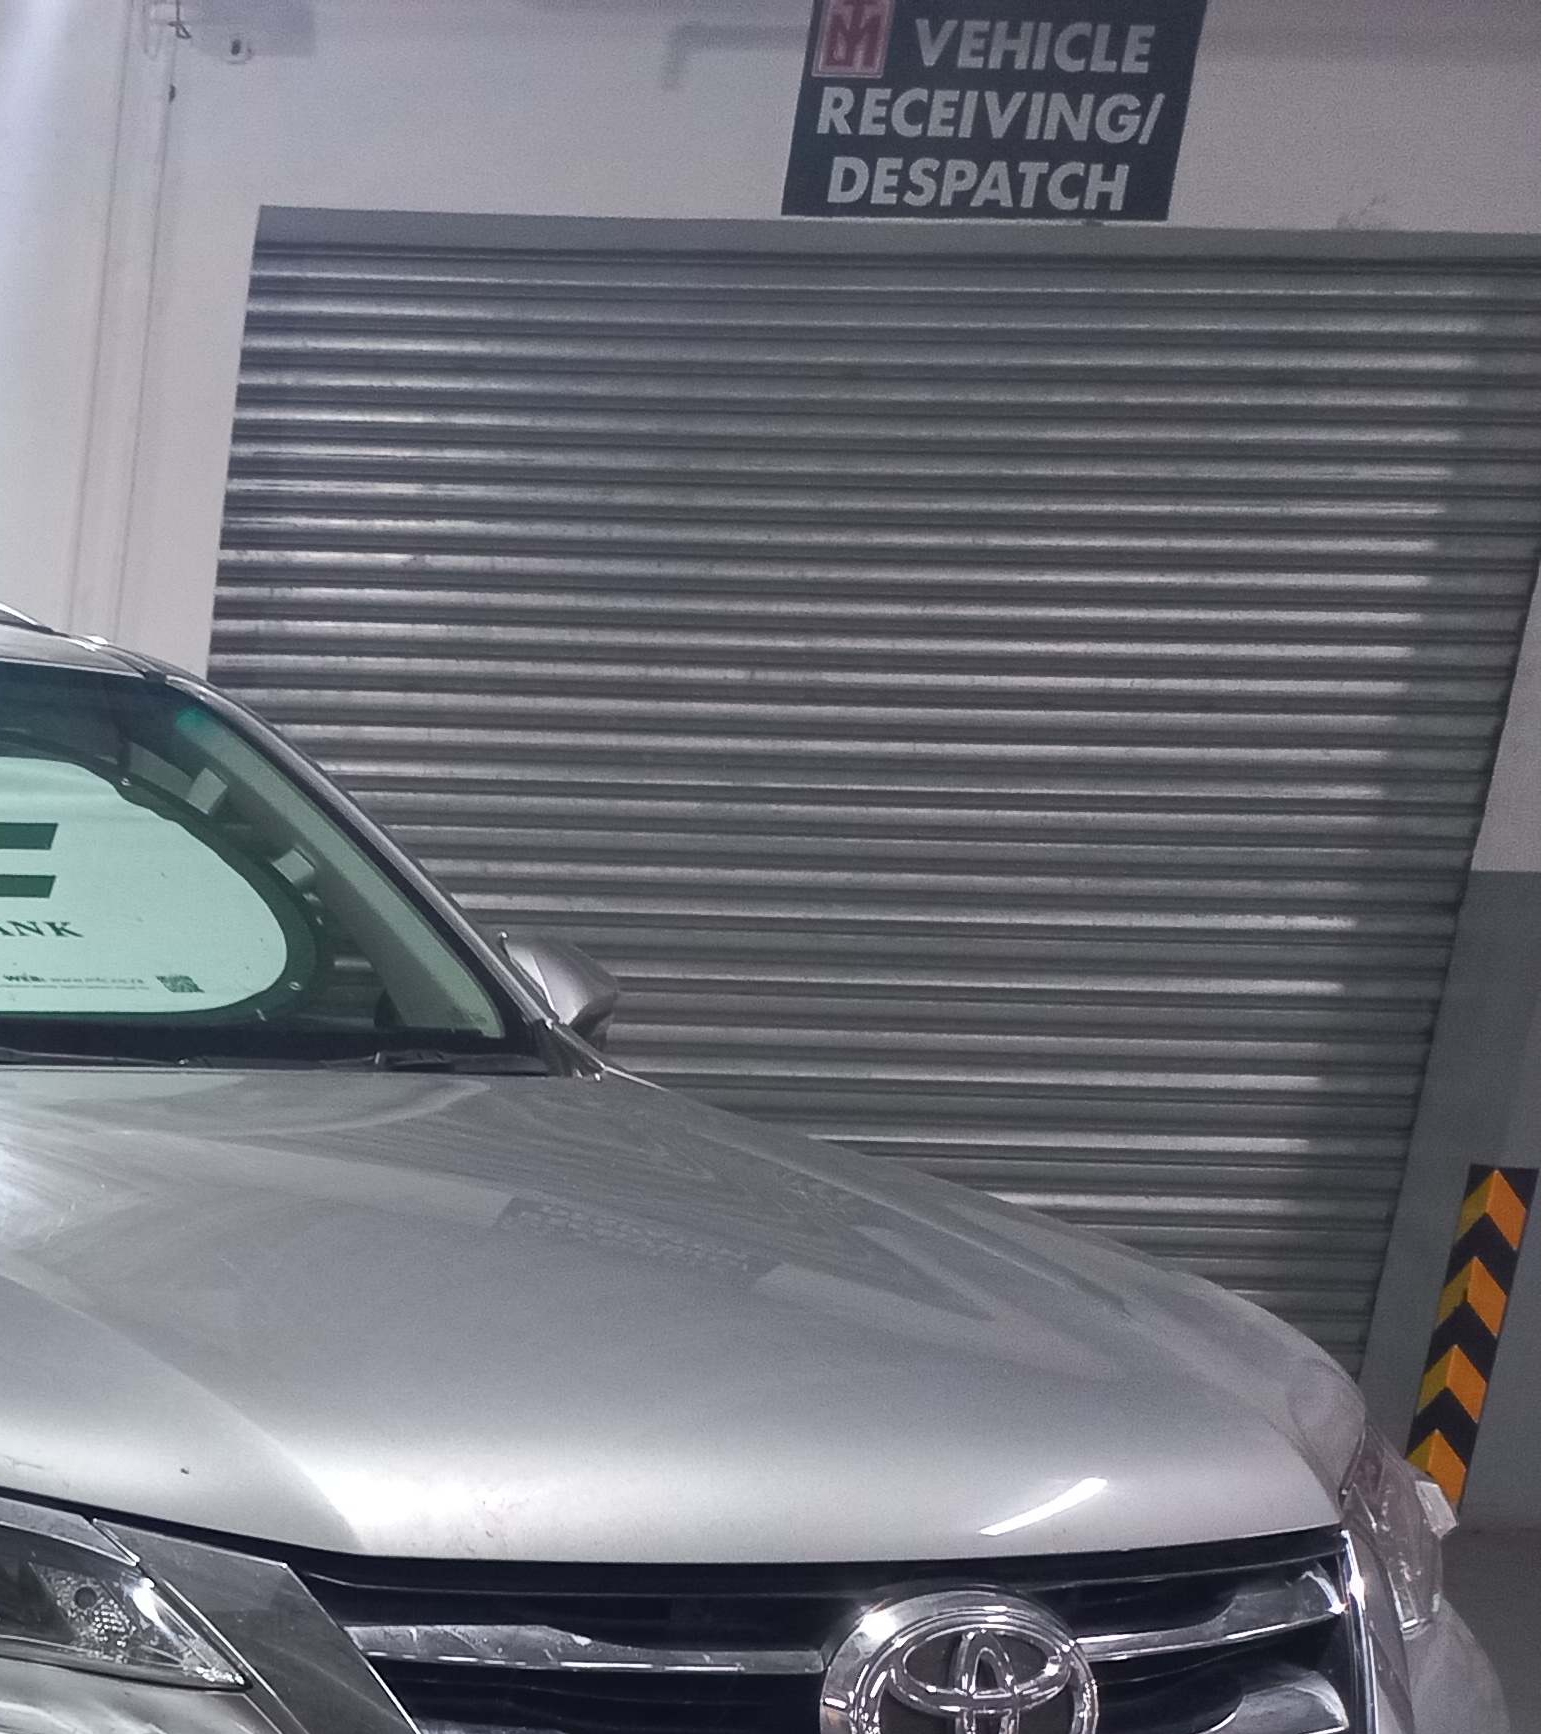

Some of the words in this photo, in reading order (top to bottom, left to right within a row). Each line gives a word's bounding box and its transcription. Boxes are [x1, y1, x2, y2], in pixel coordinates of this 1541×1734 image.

[916, 18, 1156, 74] VEHICLE
[816, 86, 1166, 145] RECEIVING/
[826, 156, 1130, 211] DESPATCH
